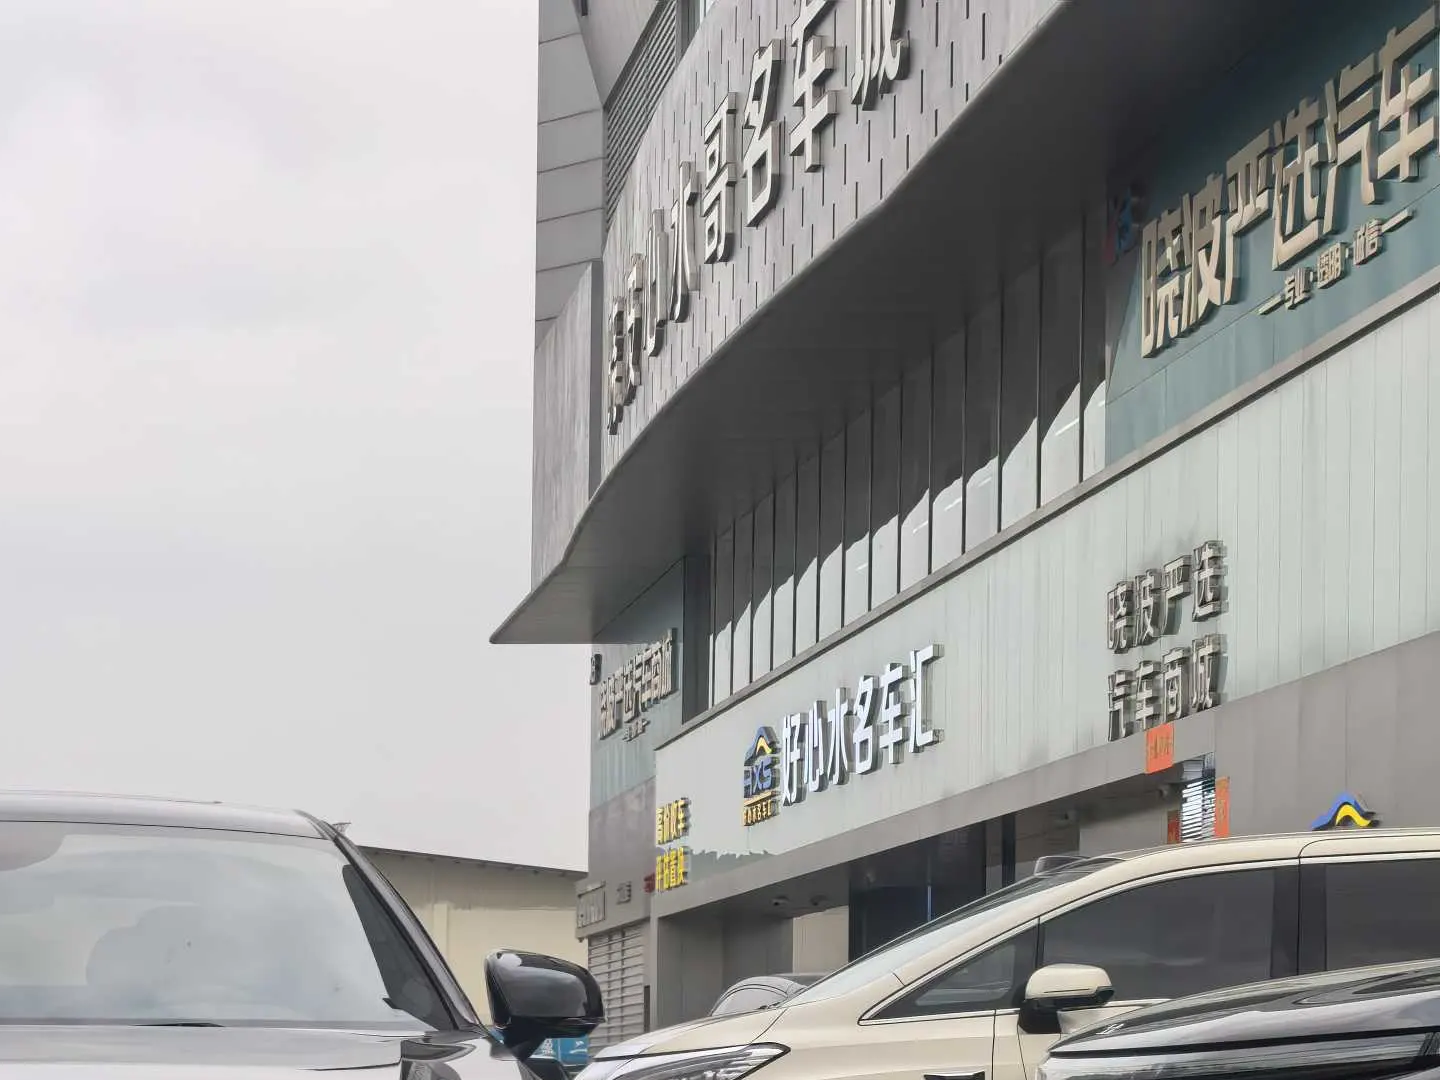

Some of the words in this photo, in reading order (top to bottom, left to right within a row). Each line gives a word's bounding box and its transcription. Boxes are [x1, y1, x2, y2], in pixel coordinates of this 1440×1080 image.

[782, 643, 944, 806] 好心水名车汇
